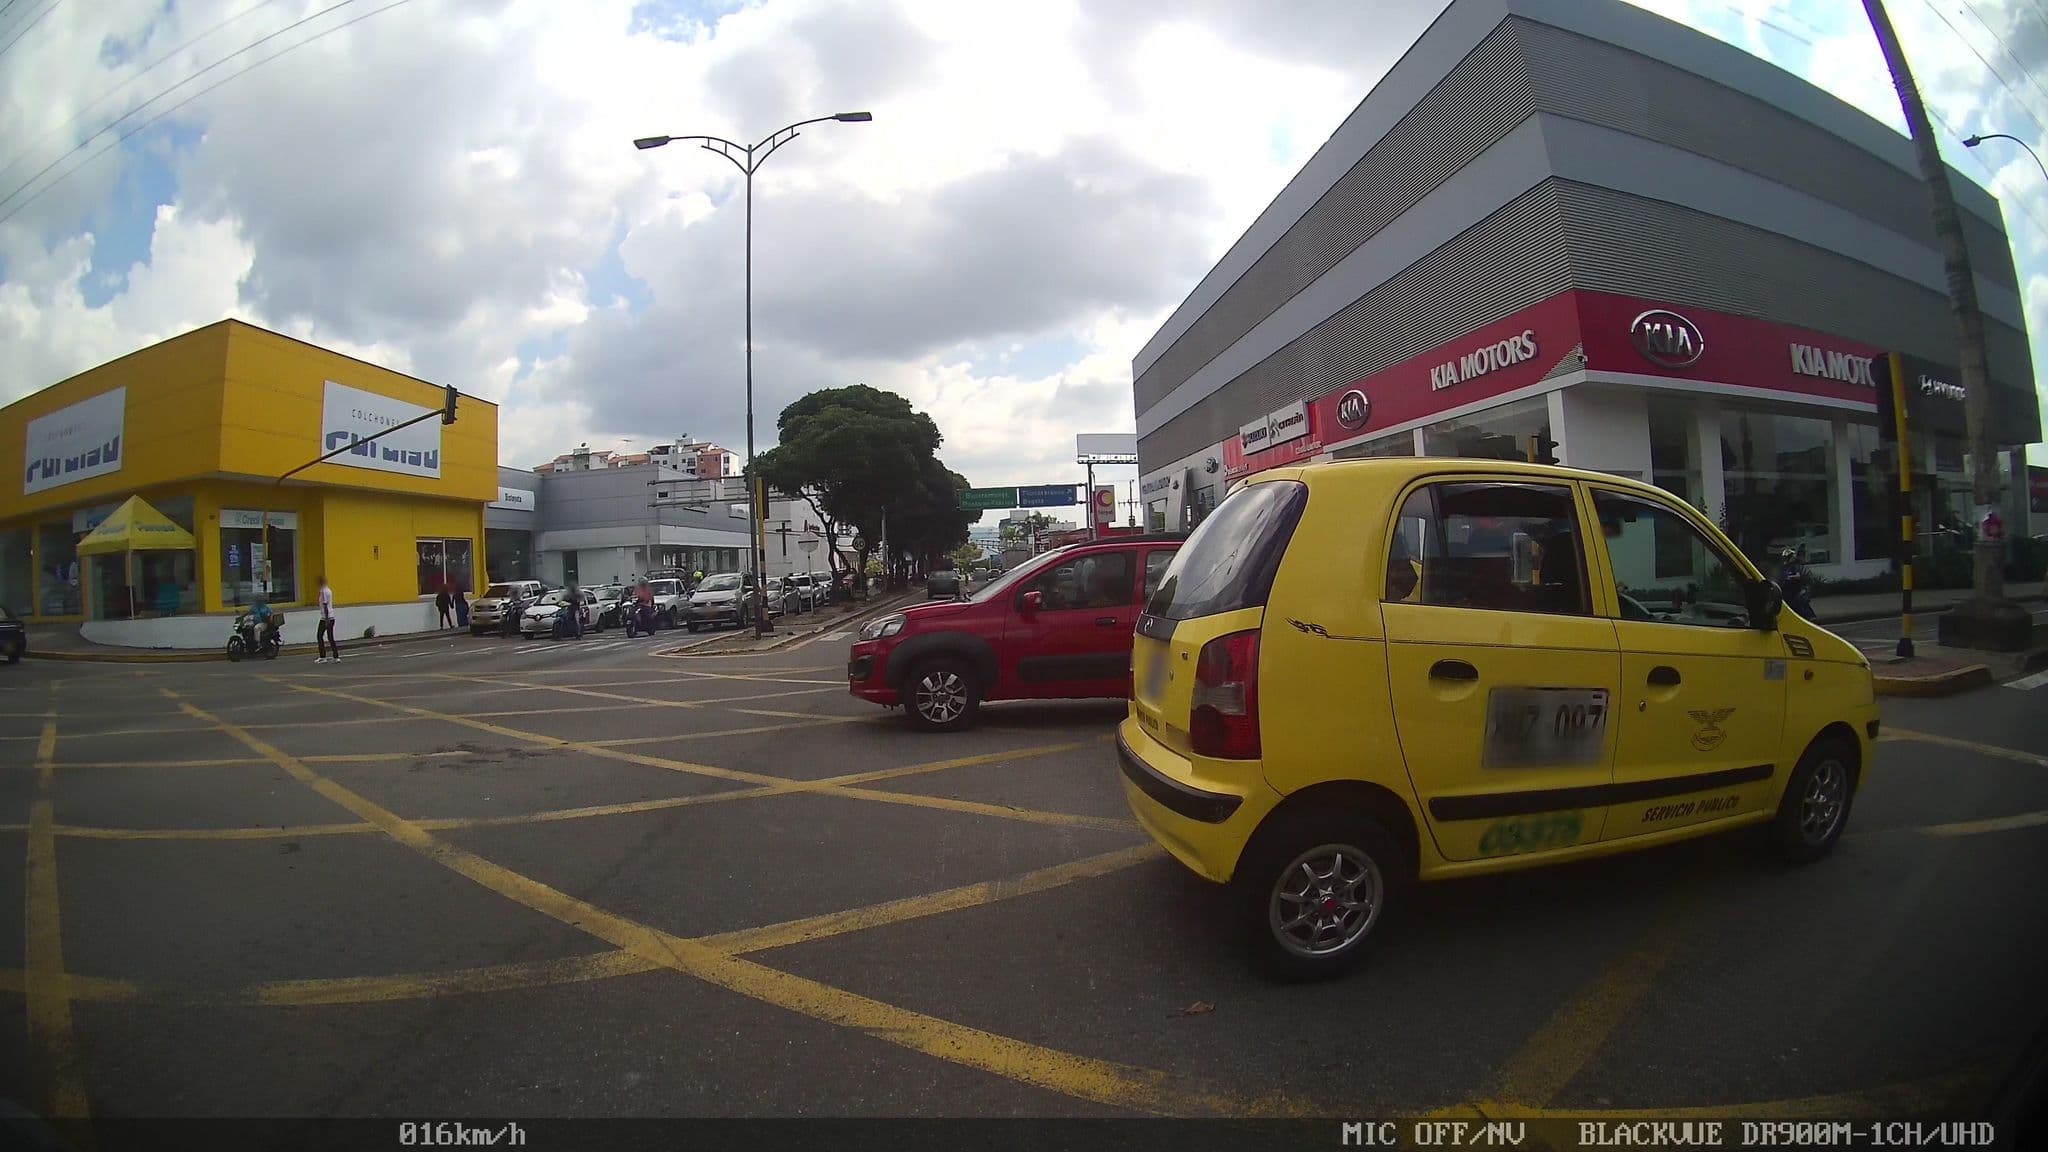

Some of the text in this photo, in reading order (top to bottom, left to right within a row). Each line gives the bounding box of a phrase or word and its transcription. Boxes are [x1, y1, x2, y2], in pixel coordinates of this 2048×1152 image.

[1430, 329, 1537, 391] KIA MOTORS
[1789, 343, 1829, 378] KIA
[1641, 802, 1696, 822] SERVICIO
